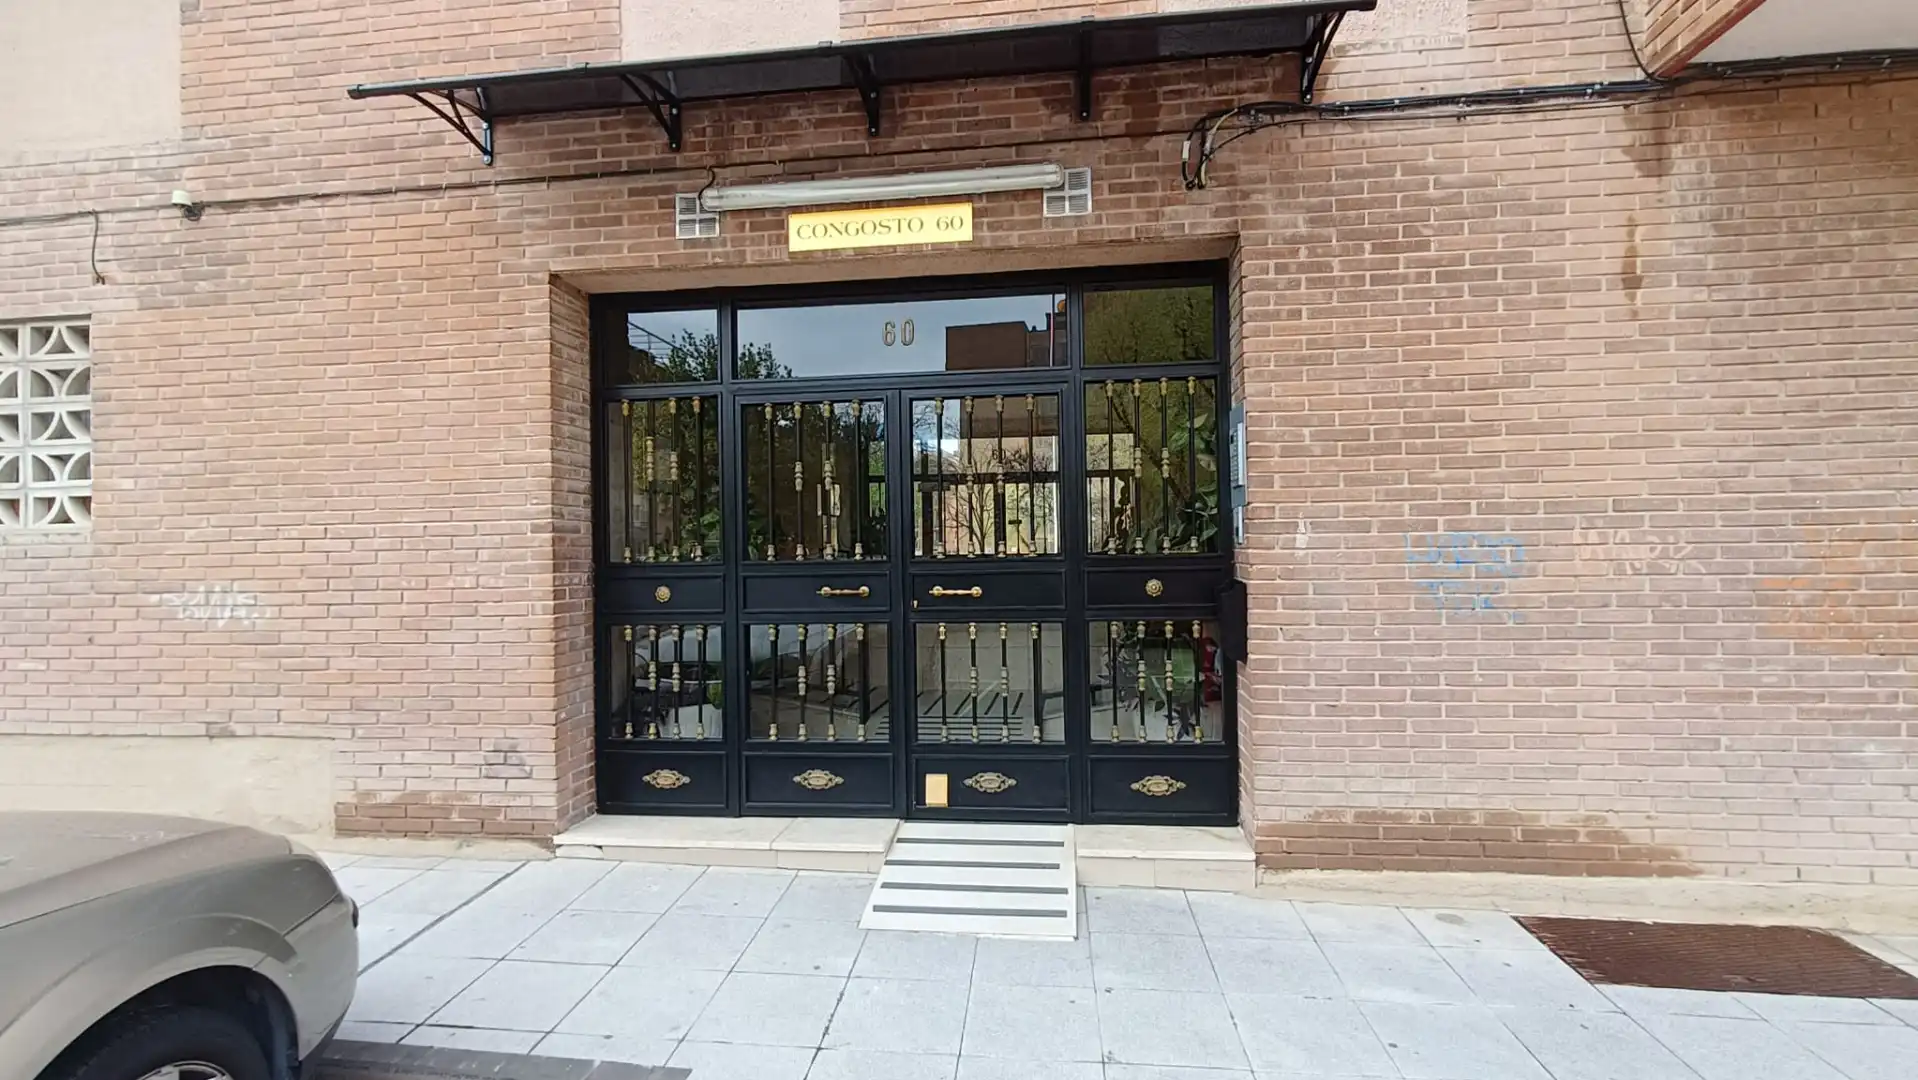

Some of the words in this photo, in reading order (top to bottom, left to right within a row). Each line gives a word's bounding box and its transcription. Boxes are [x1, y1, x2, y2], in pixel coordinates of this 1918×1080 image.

[796, 216, 924, 240] CONGOSTO
[936, 215, 964, 232] 60
[882, 319, 915, 347] 60
